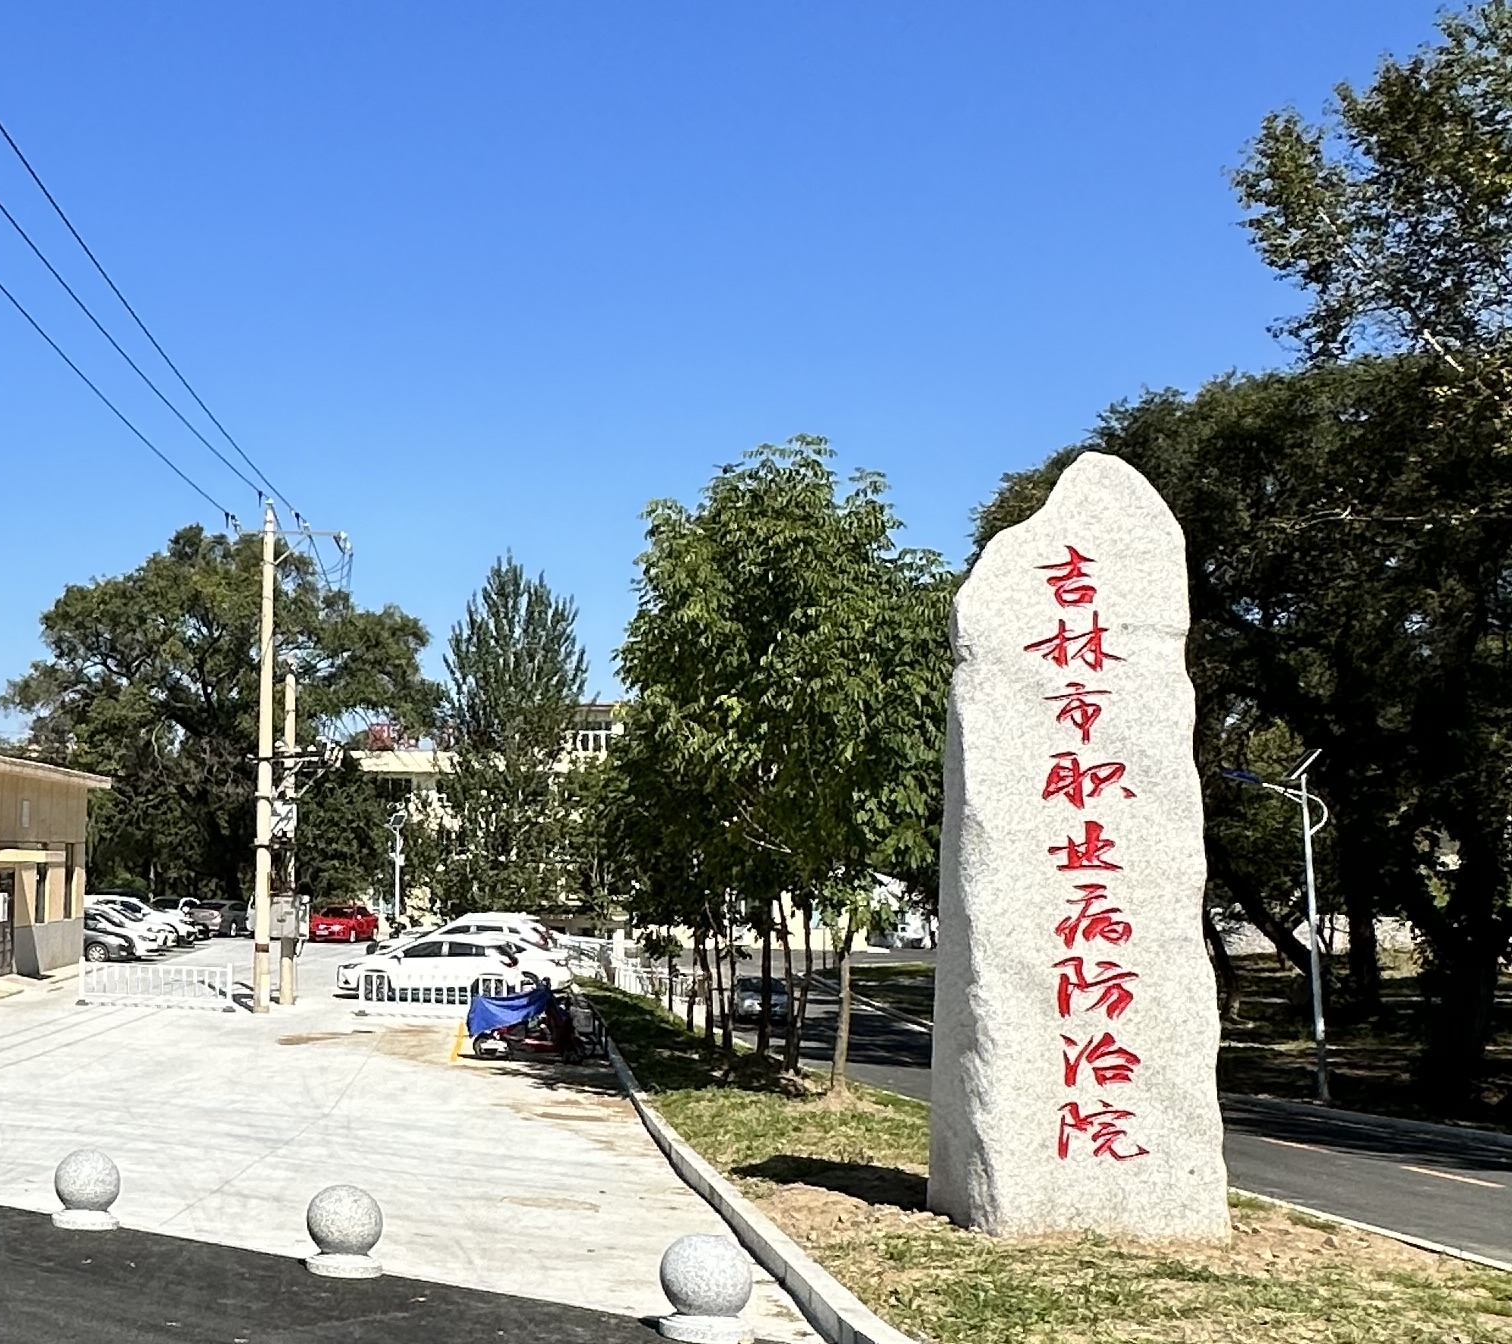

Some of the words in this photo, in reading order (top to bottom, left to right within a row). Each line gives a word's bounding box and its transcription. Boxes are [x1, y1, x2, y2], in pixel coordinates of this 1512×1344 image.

[1024, 545, 1150, 1163] 吉林市职业病防治院
